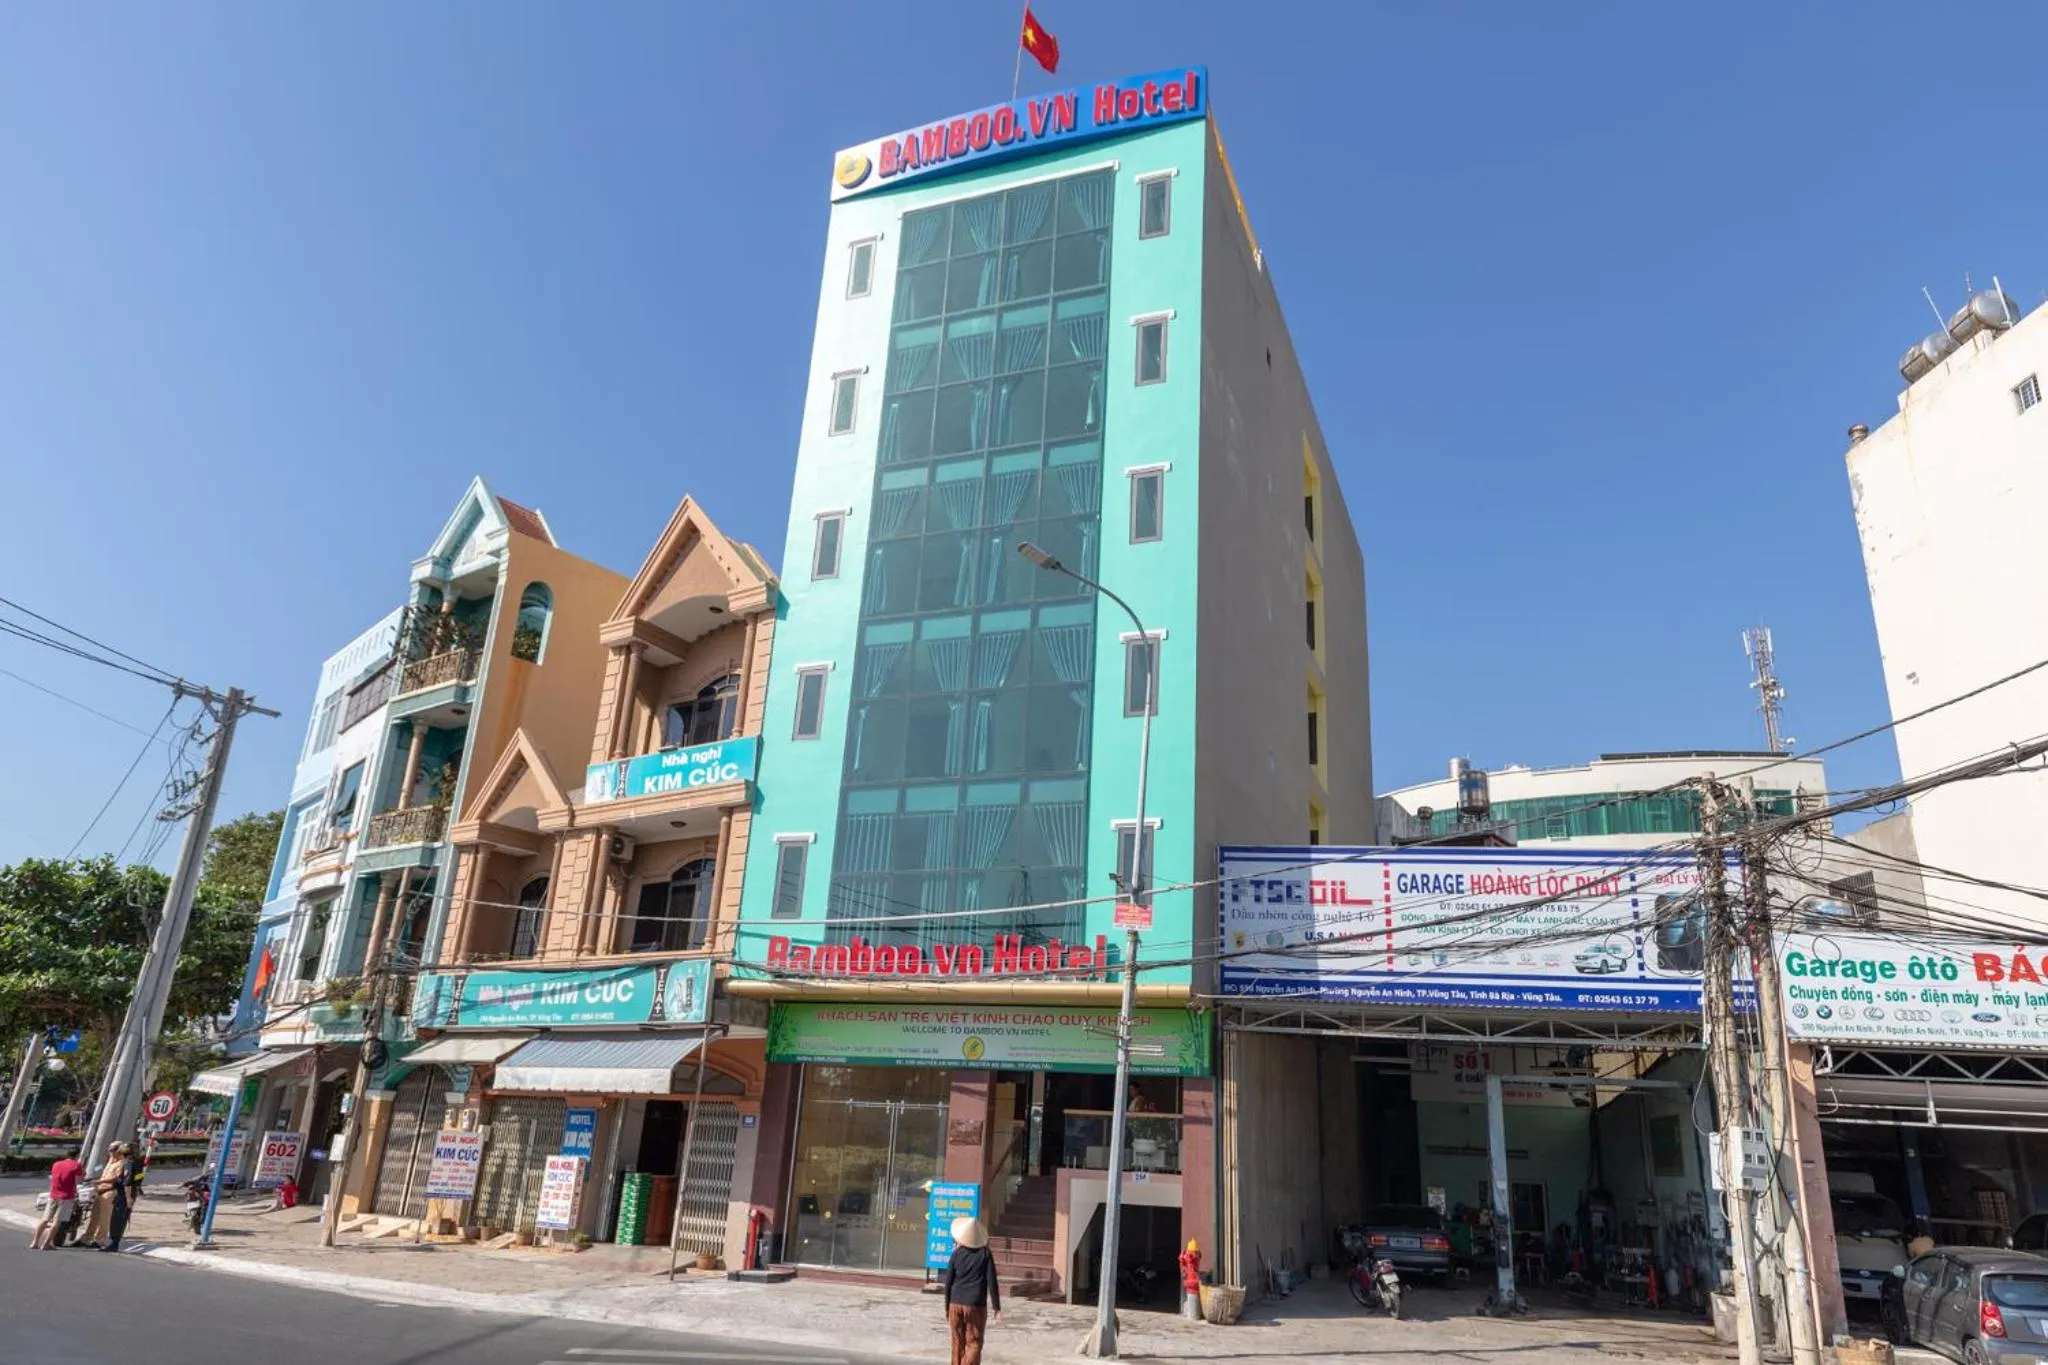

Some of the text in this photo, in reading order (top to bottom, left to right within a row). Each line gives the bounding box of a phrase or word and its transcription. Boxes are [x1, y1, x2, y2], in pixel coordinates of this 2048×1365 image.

[878, 71, 1199, 177] BAMBOO.VN Hotel
[643, 762, 740, 794] KIM CÚC
[1397, 872, 1465, 895] GARAGE
[1470, 867, 1532, 897] HOÀNG
[765, 933, 1108, 976] Bamboo.vn Hotel
[1785, 944, 2048, 985] Garage ôtô BÁ
[540, 981, 580, 1005] KIM
[1256, 983, 1285, 995] Nguyễn
[1286, 986, 1297, 994] An
[1351, 985, 1381, 998] Nguyễn
[1382, 988, 1393, 997] An
[1394, 988, 1416, 998] Ninh,
[1594, 994, 1621, 1004] 02543
[1622, 996, 1634, 1005] 61
[1635, 996, 1647, 1005] 37
[1648, 996, 1660, 1006] 79
[1789, 985, 1838, 1002] Chuyên
[1920, 988, 1949, 1008] điện
[1952, 988, 1980, 1008] máy
[1992, 990, 2020, 1009] máy
[903, 1024, 948, 1034] WELCOME
[951, 1026, 962, 1035] TO
[1020, 1027, 1051, 1037] HOTEL
[153, 1099, 170, 1114] 50
[266, 1143, 297, 1157] 602
[435, 1145, 479, 1161] KIM CÚC
